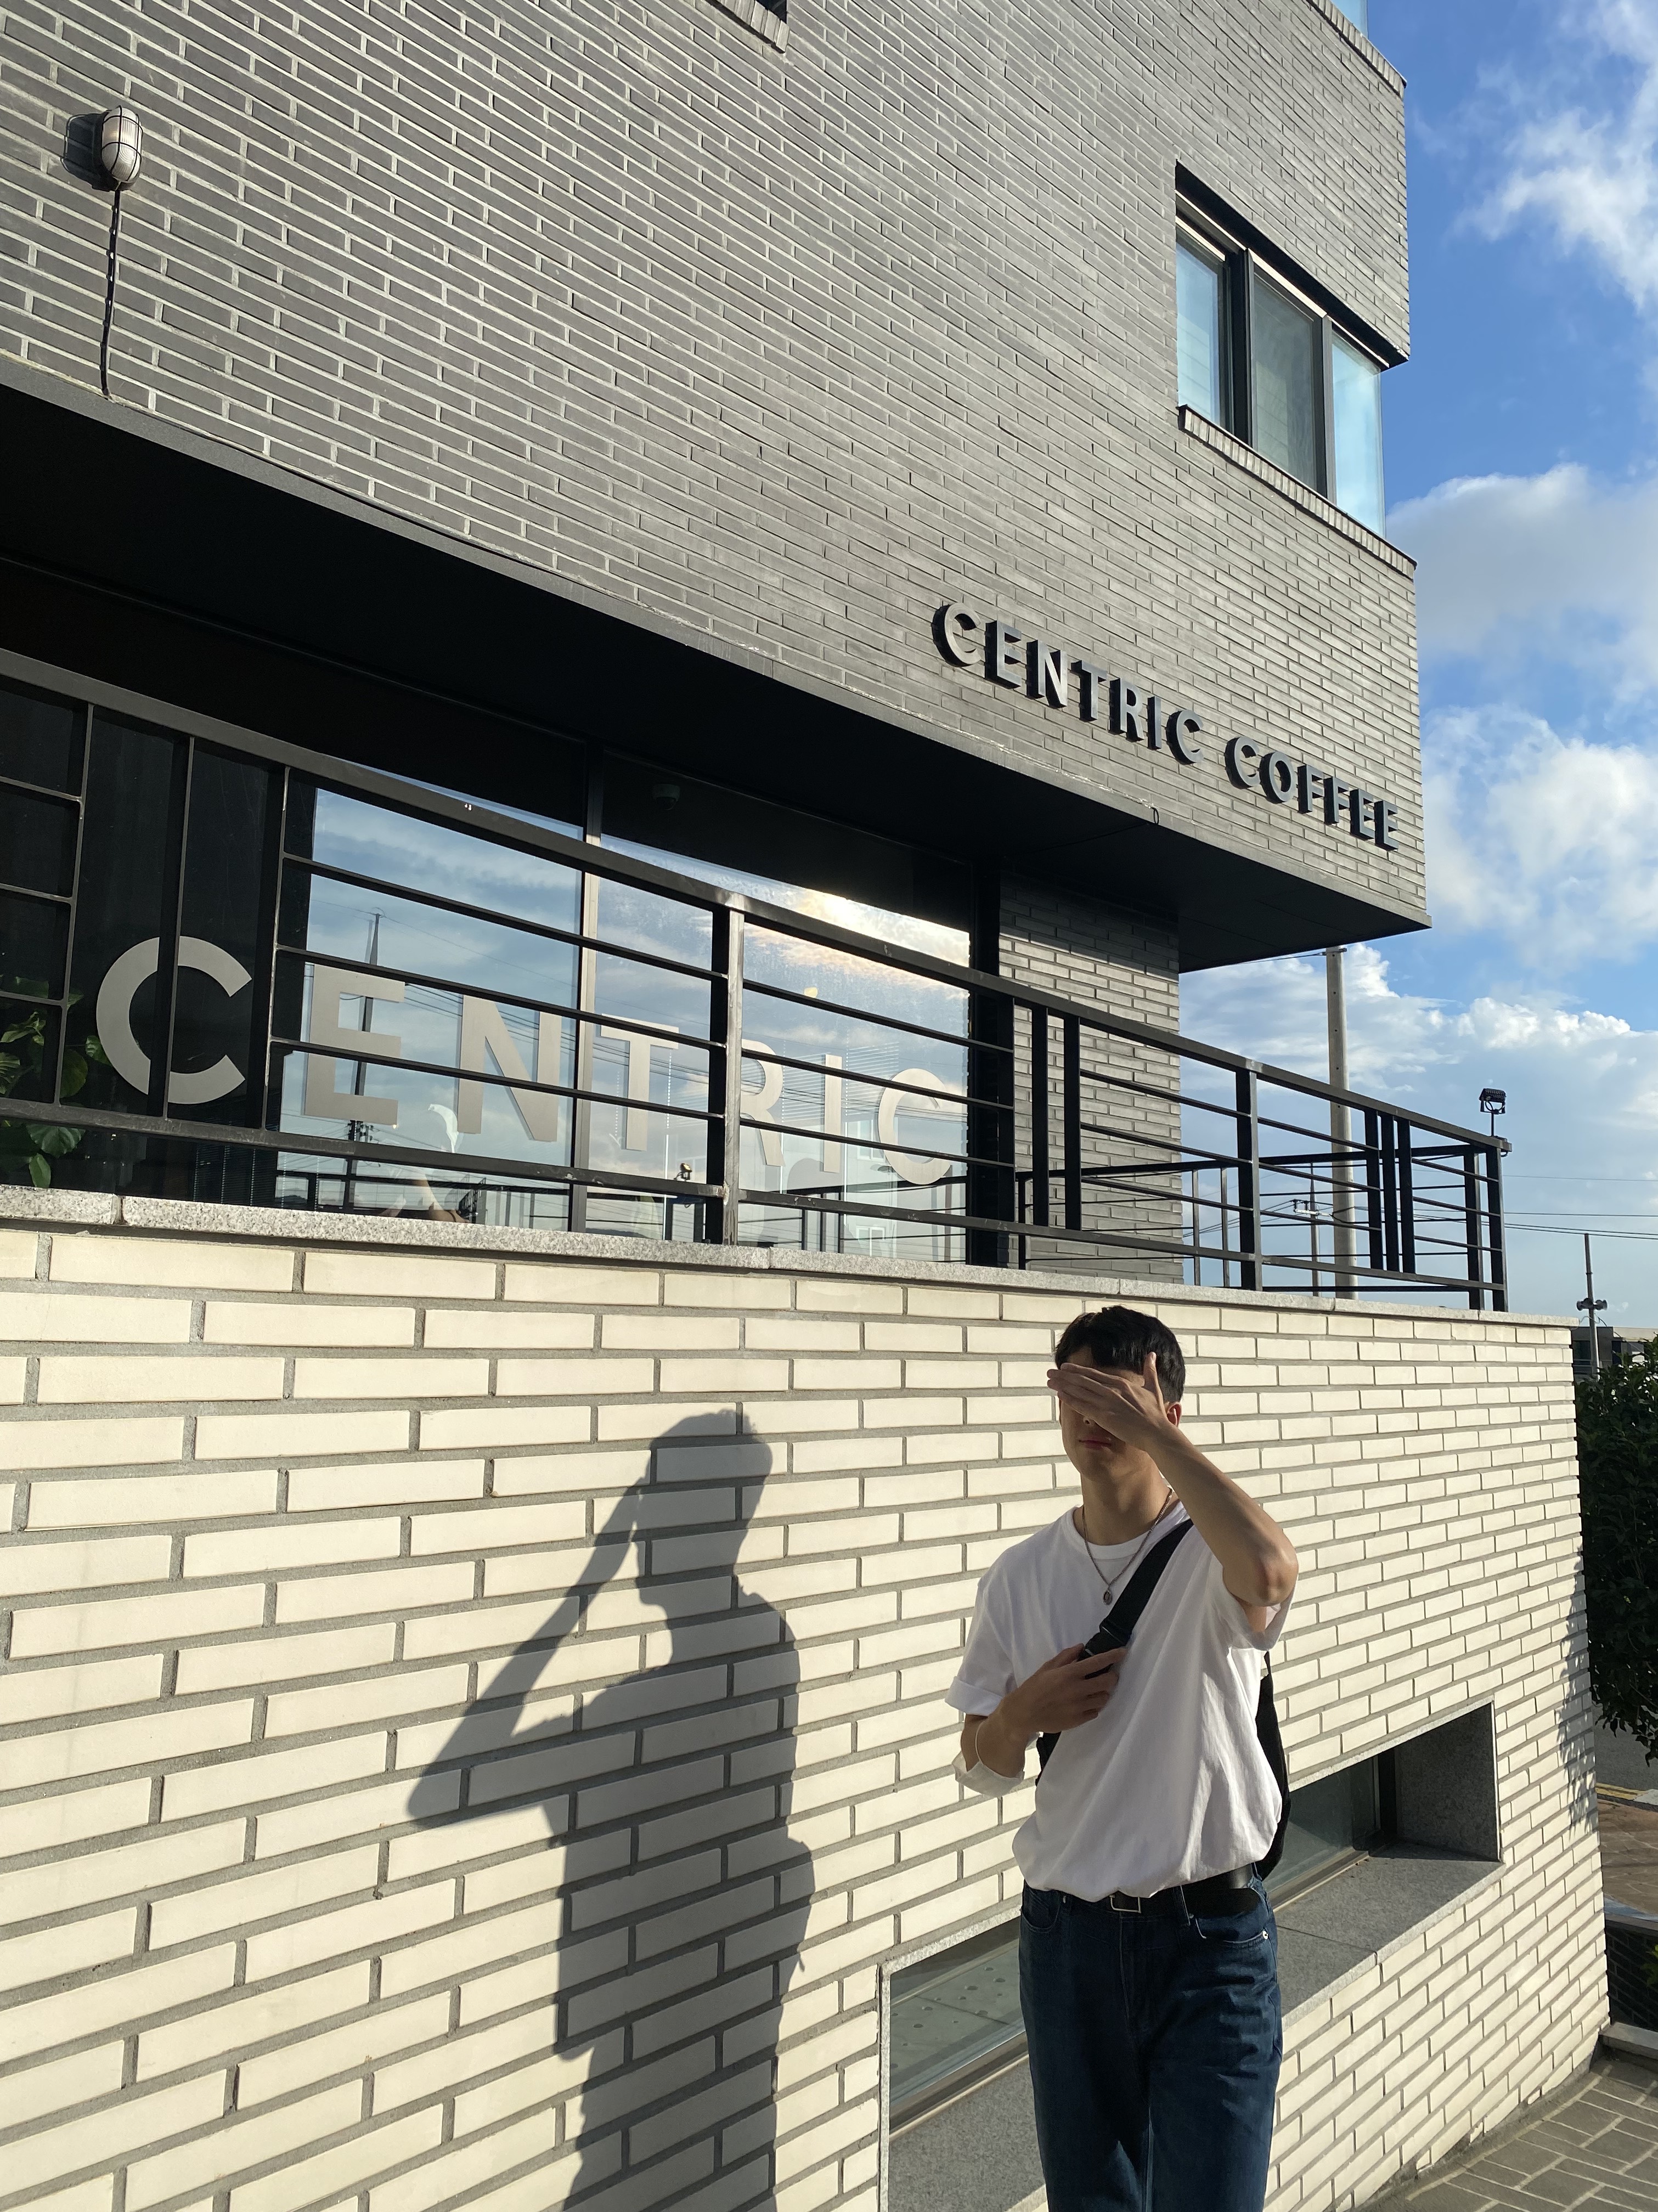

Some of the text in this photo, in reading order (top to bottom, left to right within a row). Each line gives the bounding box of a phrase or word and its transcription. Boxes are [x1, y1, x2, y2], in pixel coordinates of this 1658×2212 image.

[932, 602, 1400, 852] CENTRIC COFFEE
[96, 935, 951, 1186] CENTRIC
